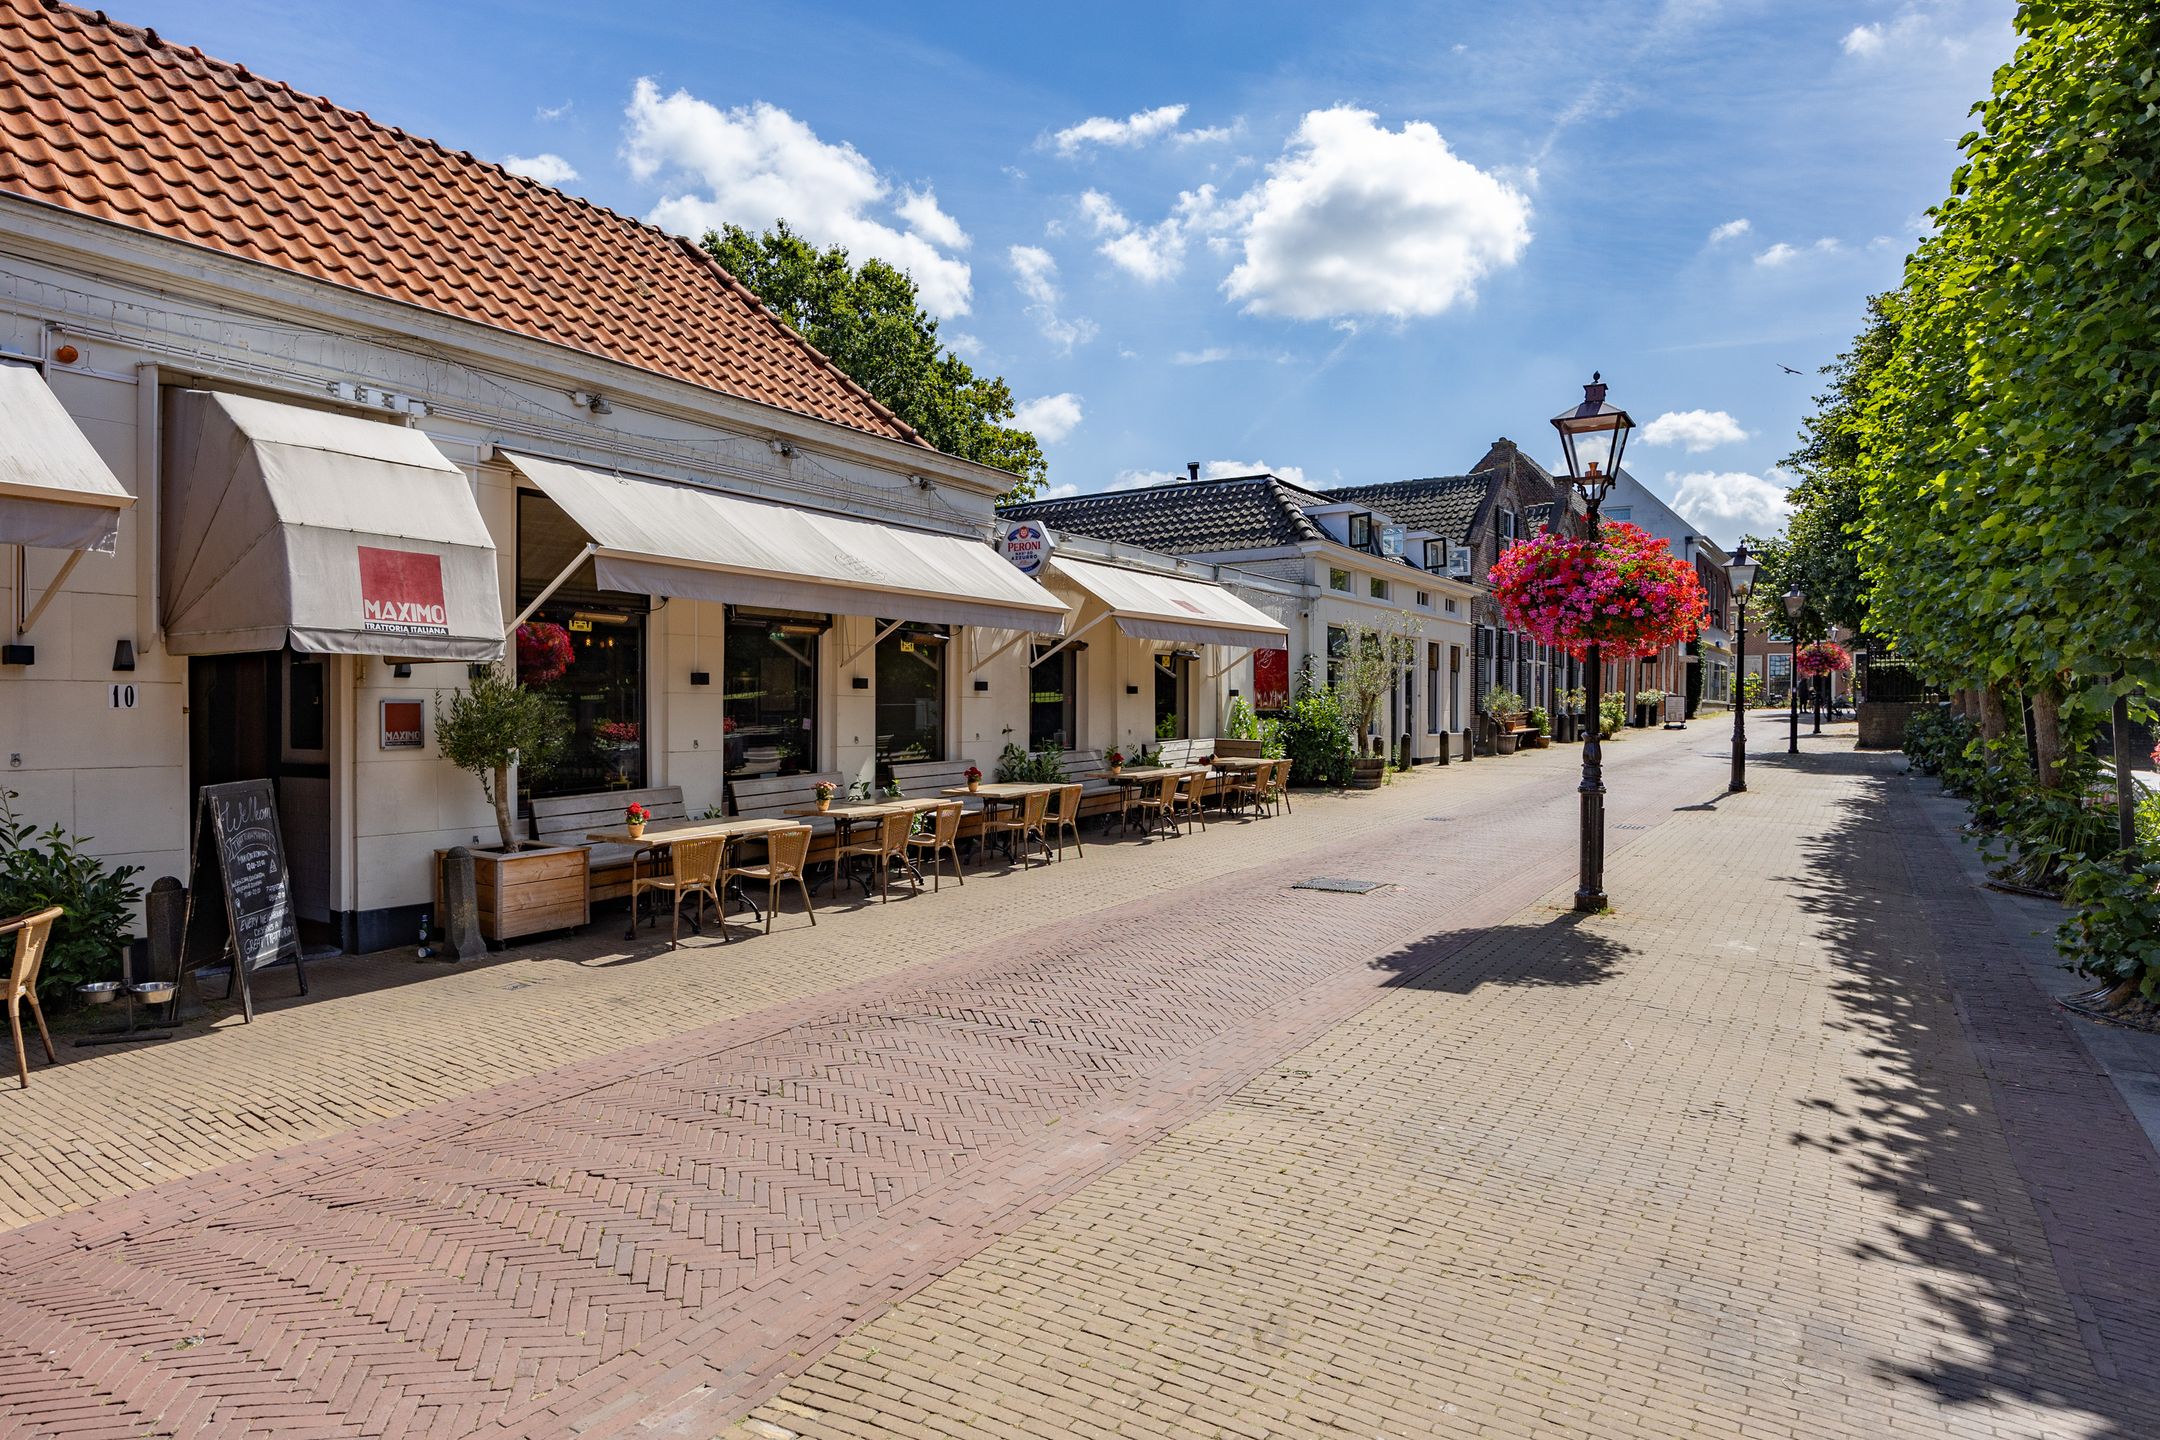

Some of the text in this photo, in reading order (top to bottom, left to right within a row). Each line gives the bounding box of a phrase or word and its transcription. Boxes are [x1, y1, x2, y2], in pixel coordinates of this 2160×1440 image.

[1008, 541, 1041, 552] PERONI
[364, 599, 445, 624] MAXIMO
[365, 623, 447, 635] TRATTORIA ITALIANA
[113, 684, 135, 708] 10
[385, 730, 421, 740] MAXIMO
[240, 916, 259, 932] EVERY
